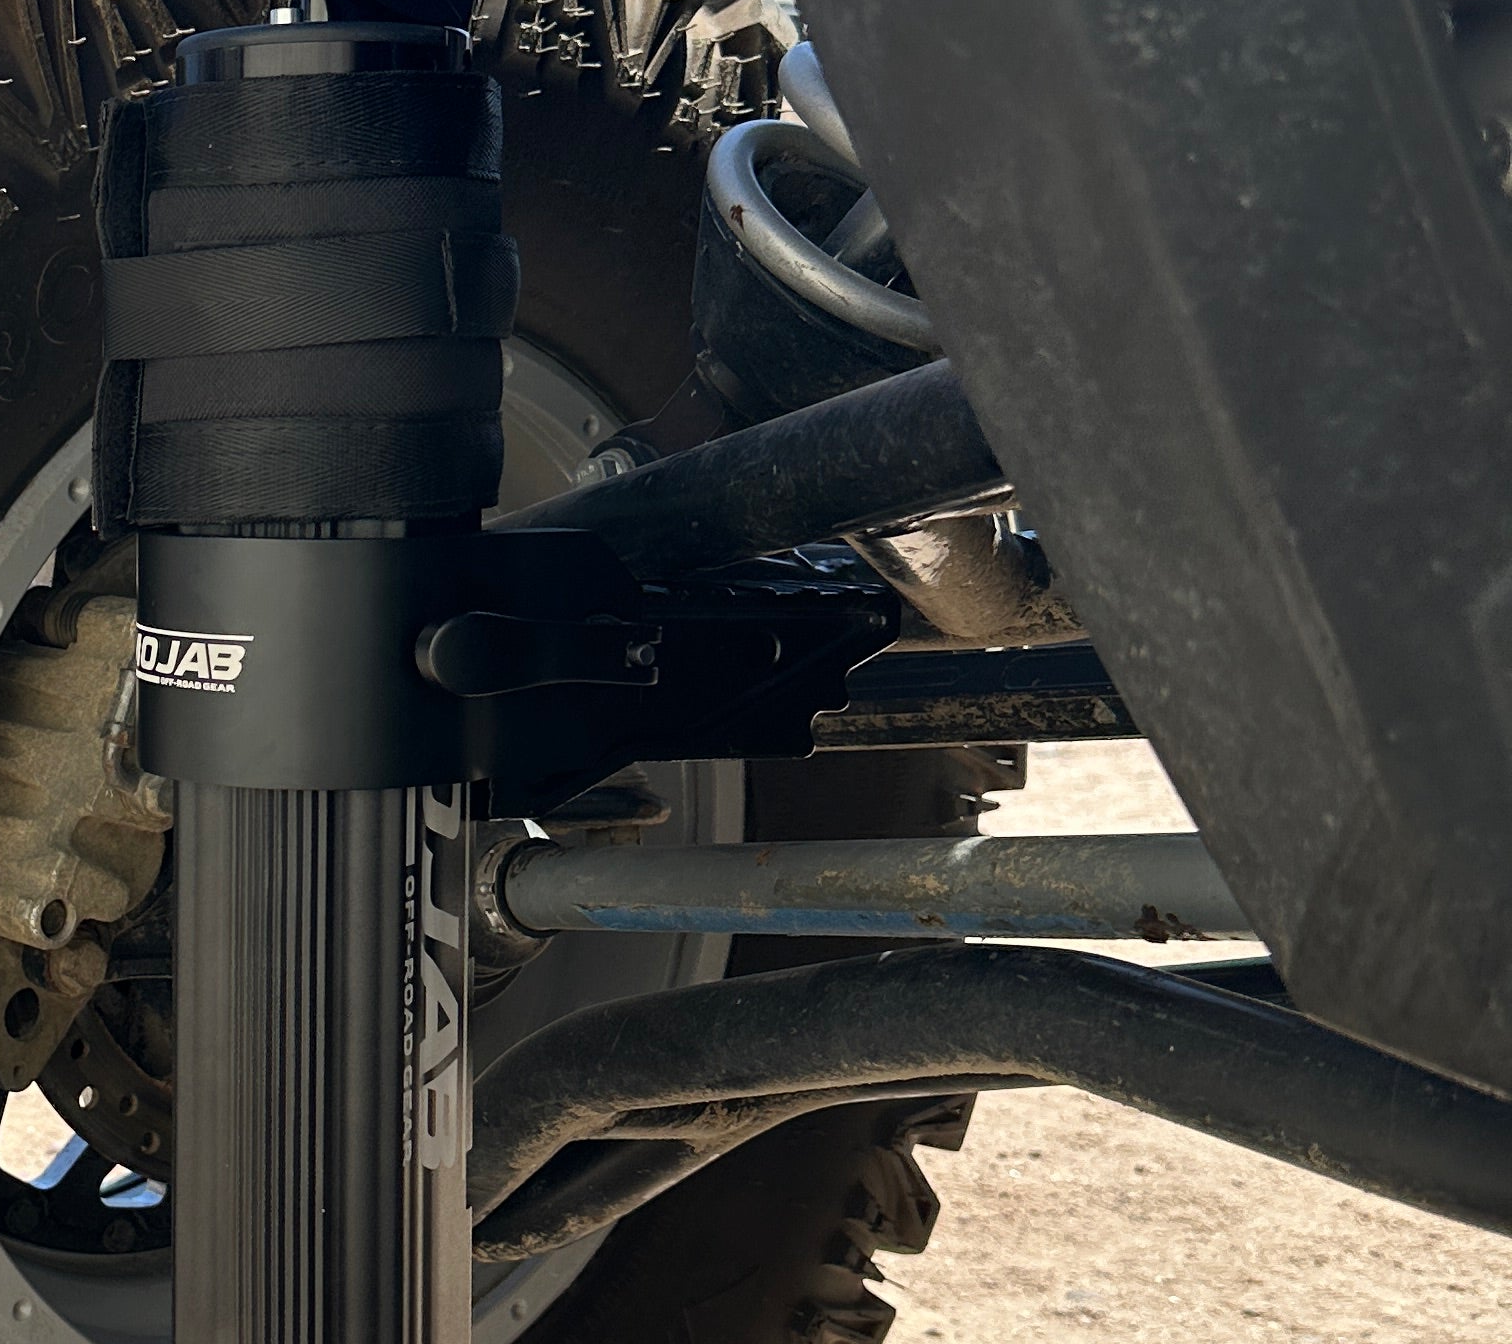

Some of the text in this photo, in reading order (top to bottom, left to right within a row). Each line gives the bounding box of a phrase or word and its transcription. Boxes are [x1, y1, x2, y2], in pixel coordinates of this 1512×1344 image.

[160, 676, 236, 693] OFF-ROAD GEAR
[402, 875, 416, 1168] OFF-ROAD GEAR
